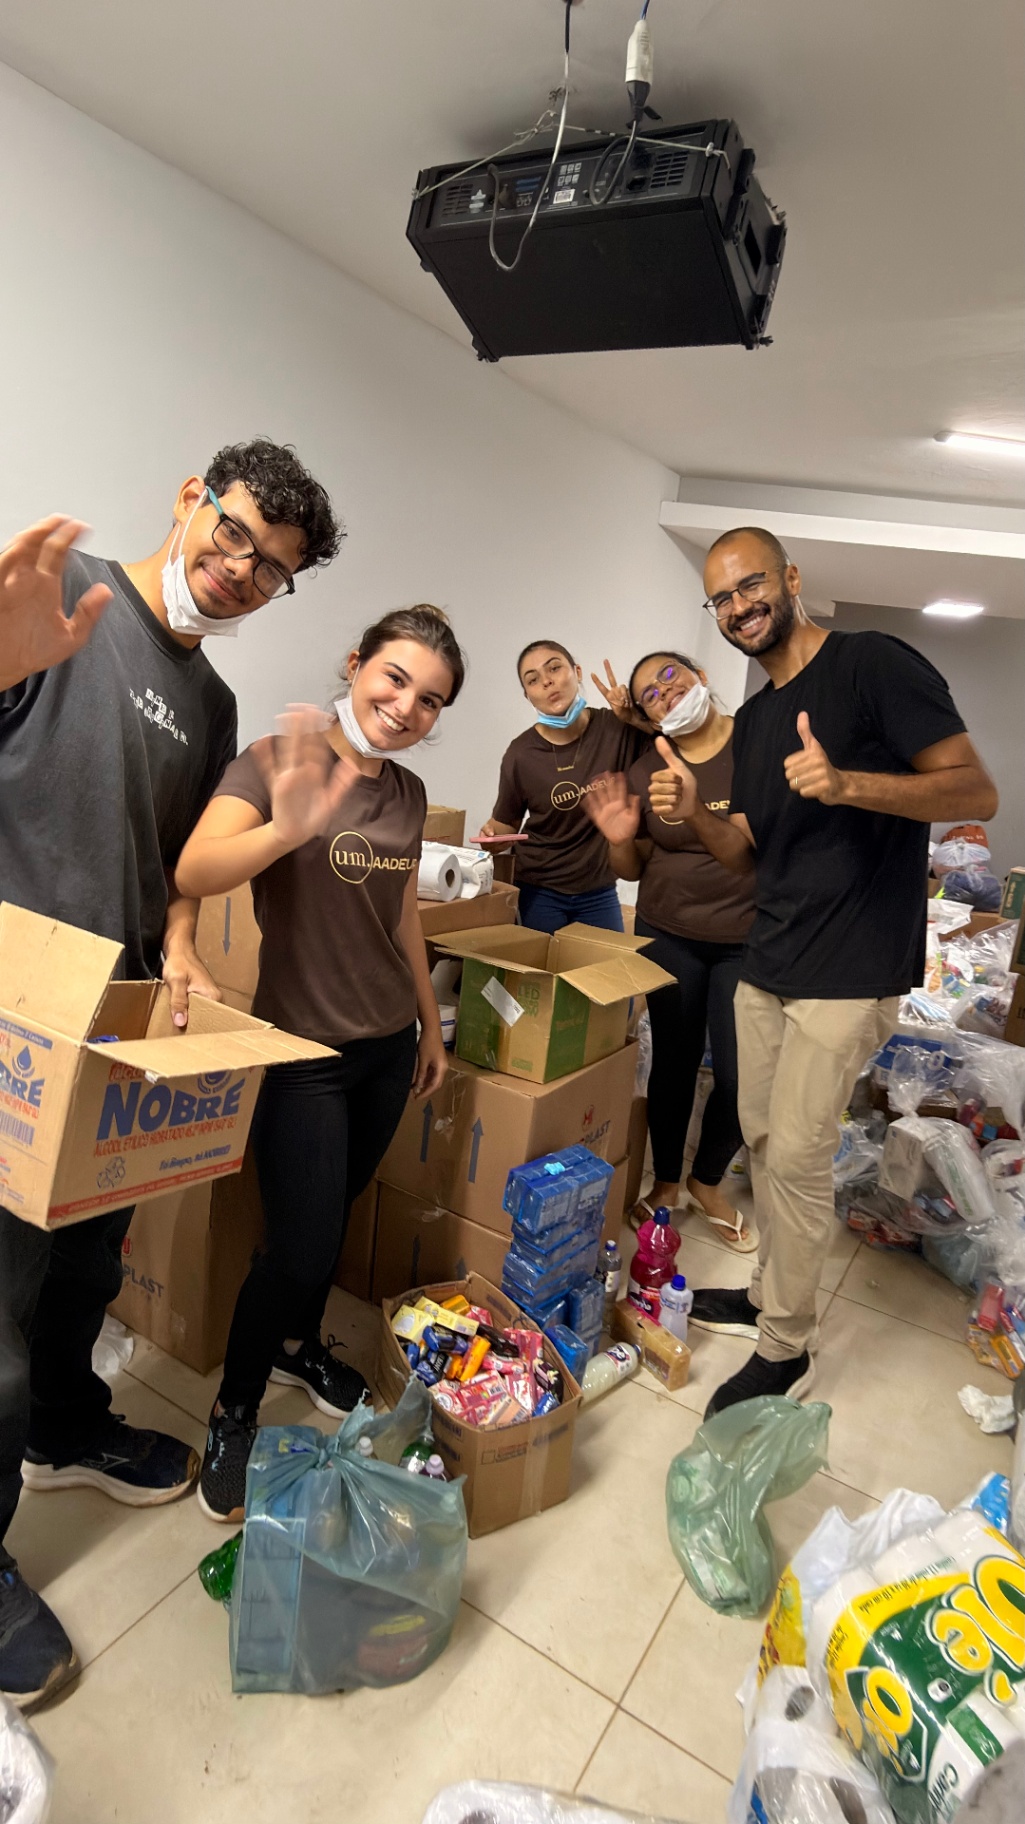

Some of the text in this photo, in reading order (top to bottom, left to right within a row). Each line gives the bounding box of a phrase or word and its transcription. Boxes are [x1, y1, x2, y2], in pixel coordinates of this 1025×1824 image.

[96, 1077, 246, 1141] NOBRE
[584, 1119, 611, 1145] PLAST
[122, 1263, 164, 1298] PLAST
